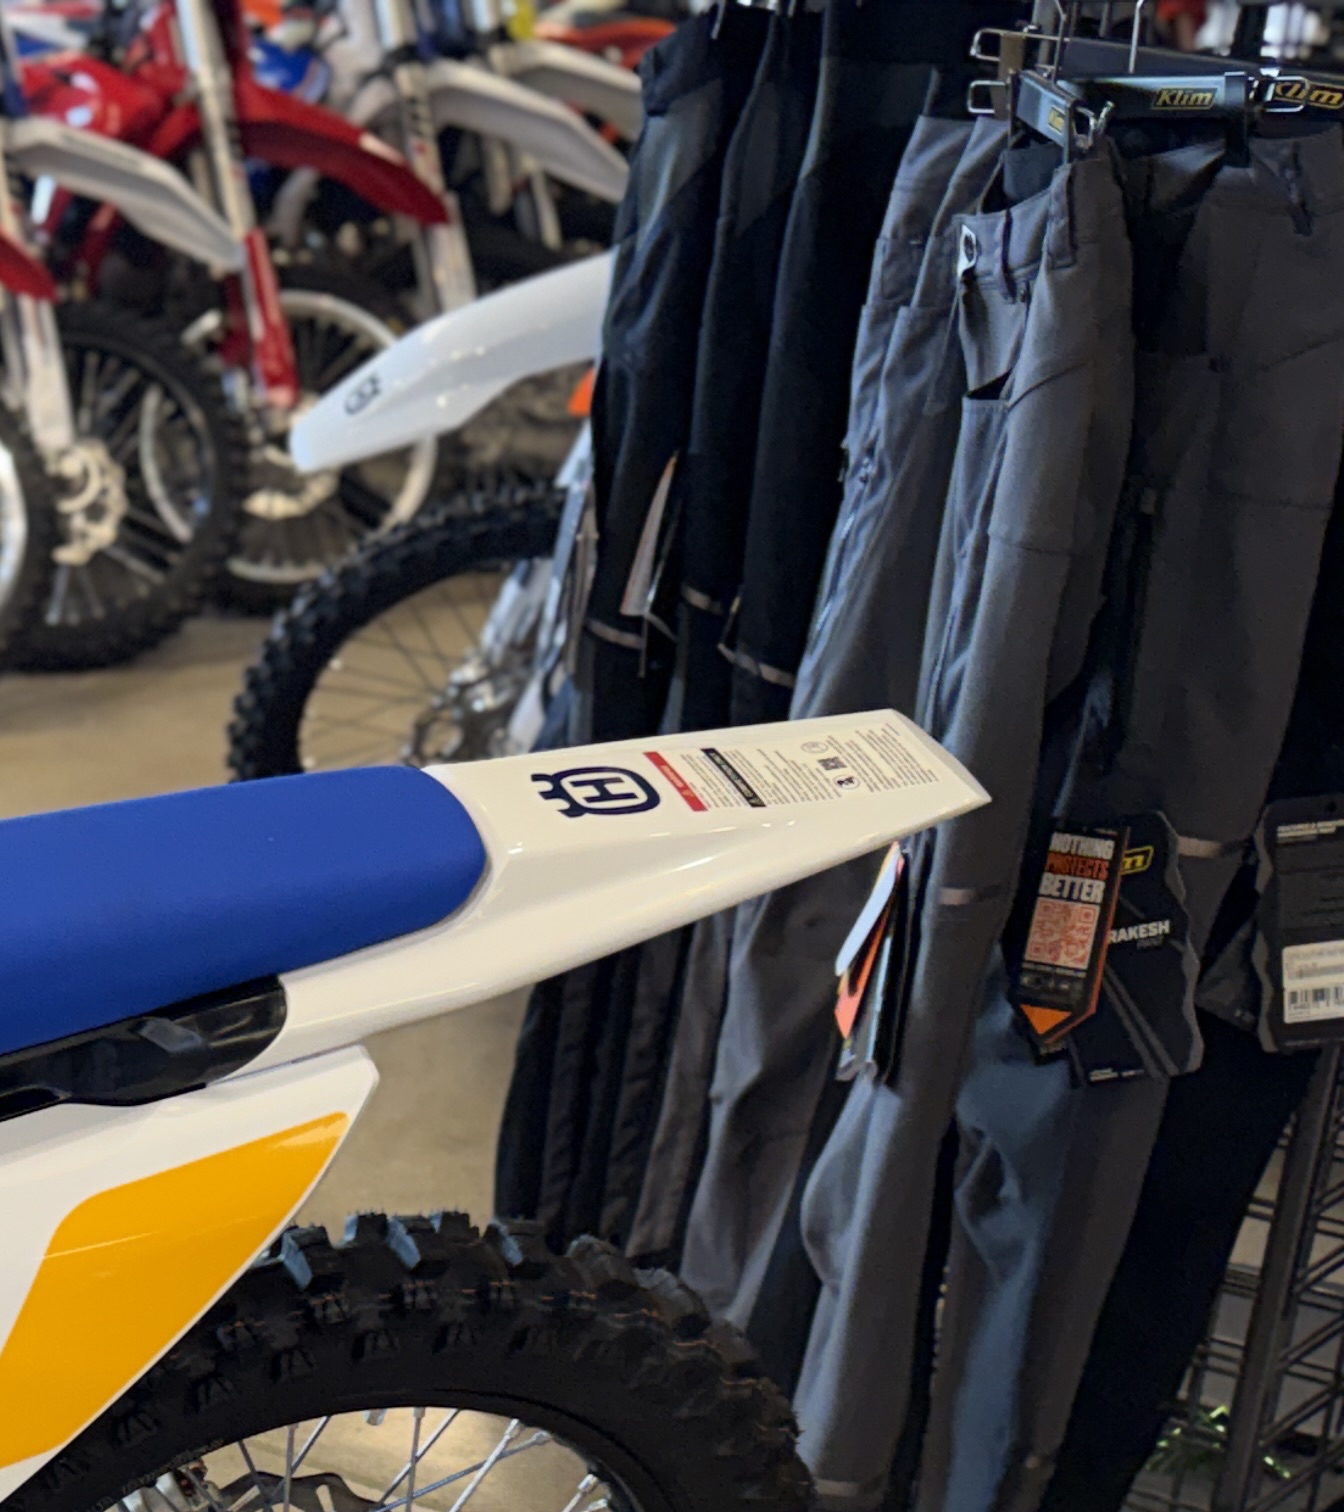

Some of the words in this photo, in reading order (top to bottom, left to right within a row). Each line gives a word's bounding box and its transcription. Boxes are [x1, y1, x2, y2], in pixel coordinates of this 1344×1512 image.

[1155, 85, 1212, 105] Klim
[1049, 832, 1115, 860] NOTHING
[1038, 872, 1106, 904] BETTER
